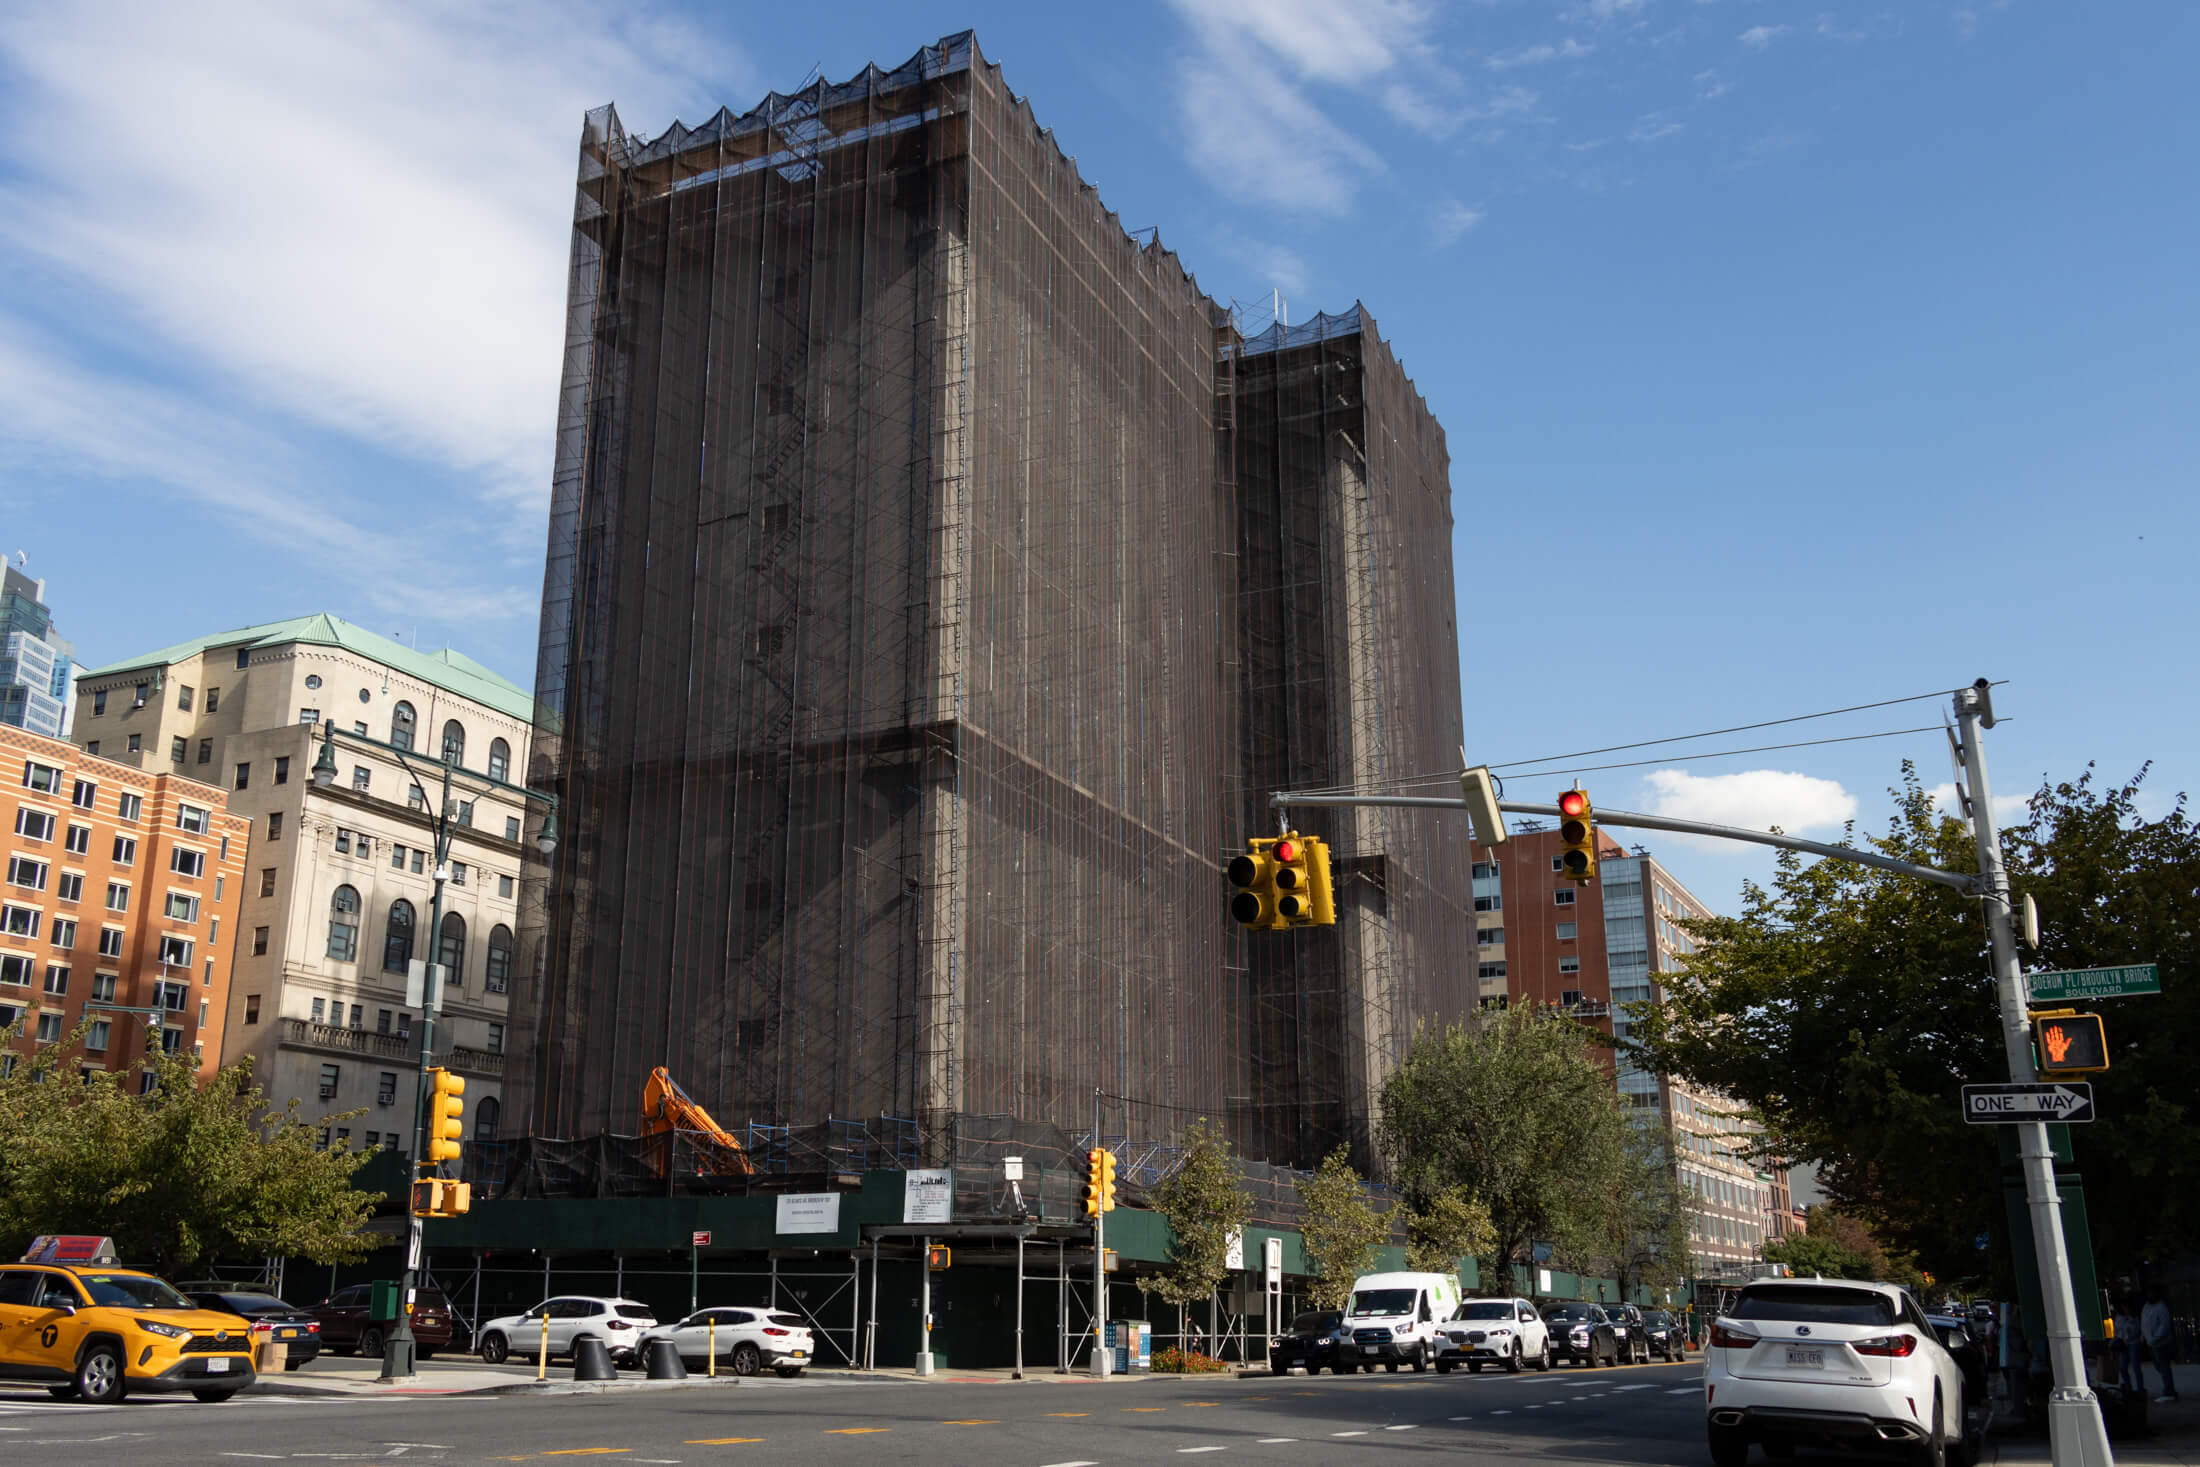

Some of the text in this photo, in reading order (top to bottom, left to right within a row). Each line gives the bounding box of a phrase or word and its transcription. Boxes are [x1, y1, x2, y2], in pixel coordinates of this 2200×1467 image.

[2032, 967, 2153, 990] BOERUM PL/BROOKLYN BRIDGE
[2065, 985, 2122, 997] BOULEVARD
[1975, 1094, 2077, 1111] ONE WAY
